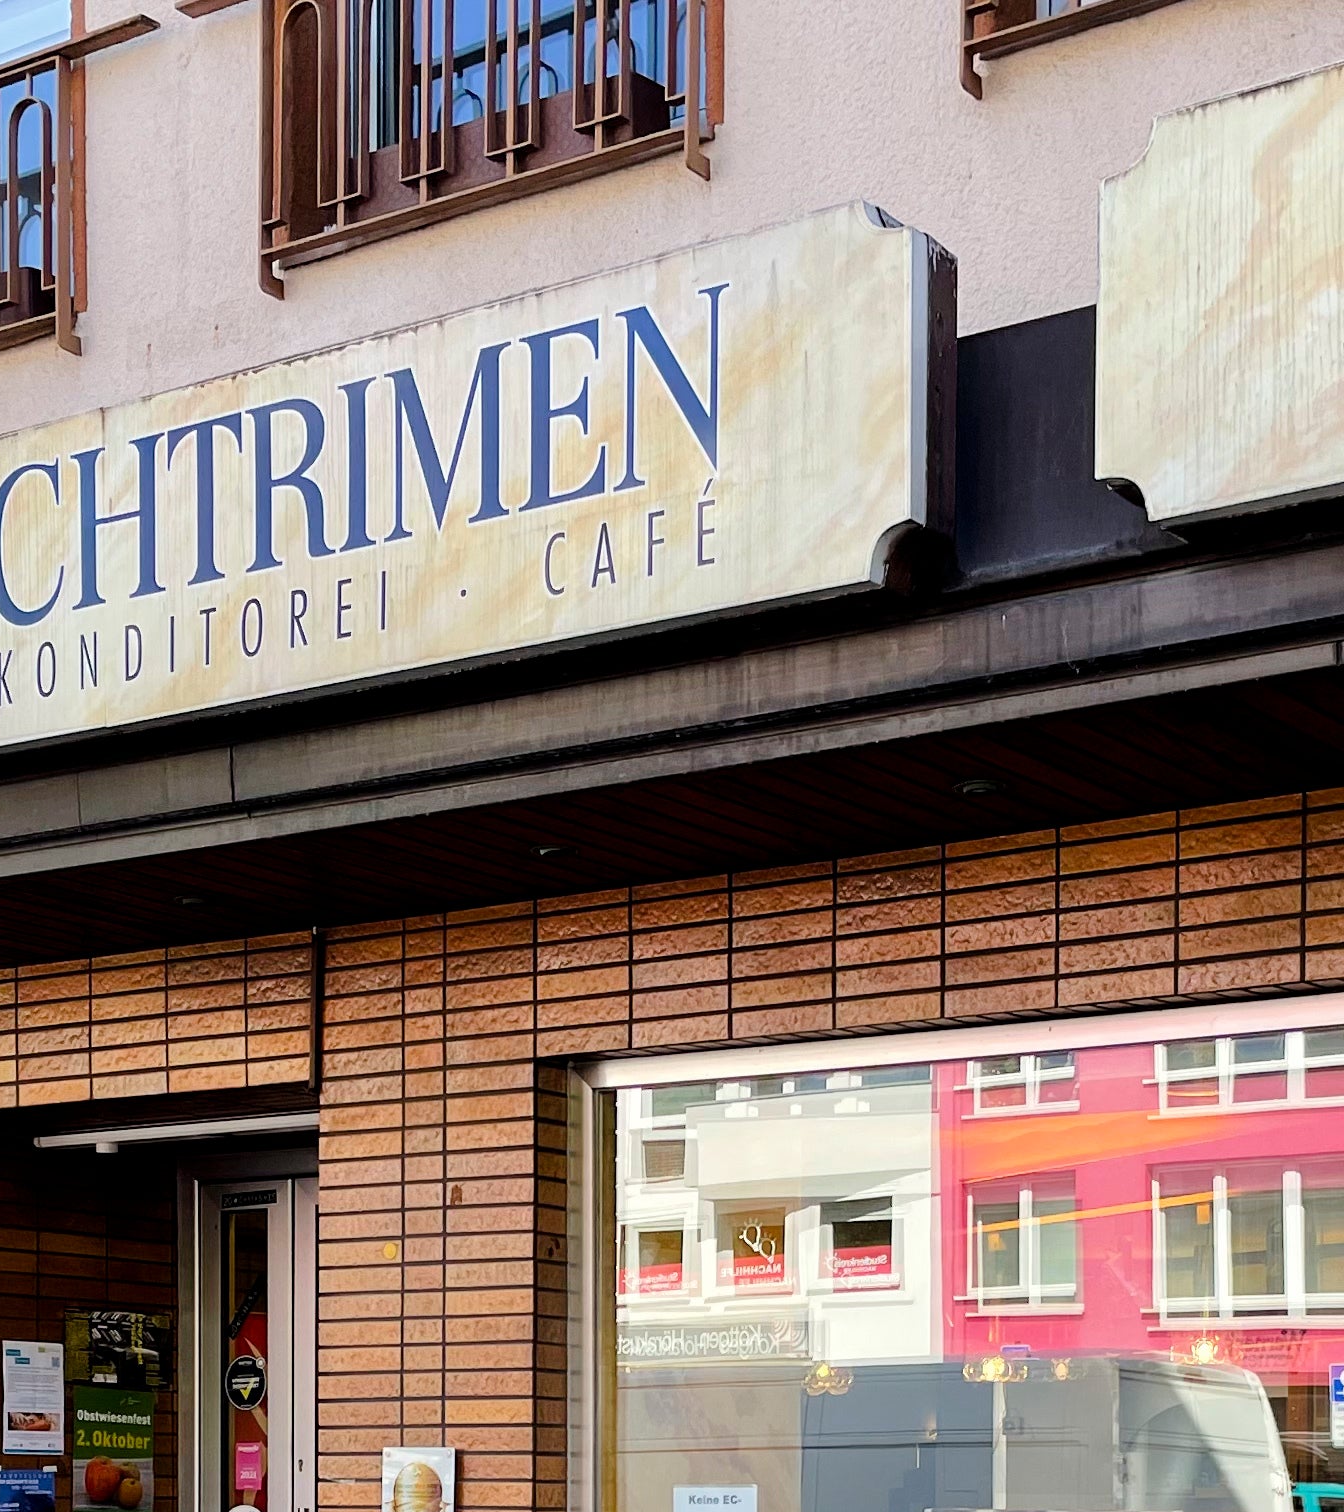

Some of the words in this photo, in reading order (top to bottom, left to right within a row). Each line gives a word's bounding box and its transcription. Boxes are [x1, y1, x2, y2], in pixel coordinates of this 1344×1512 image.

[543, 478, 719, 598] CAFÉ
[76, 1409, 152, 1426] Obstwiesenfest
[76, 1429, 91, 1447] 2.
[92, 1430, 151, 1450] Oktober
[688, 1495, 720, 1505] Keine
[722, 1495, 743, 1505] EC-
